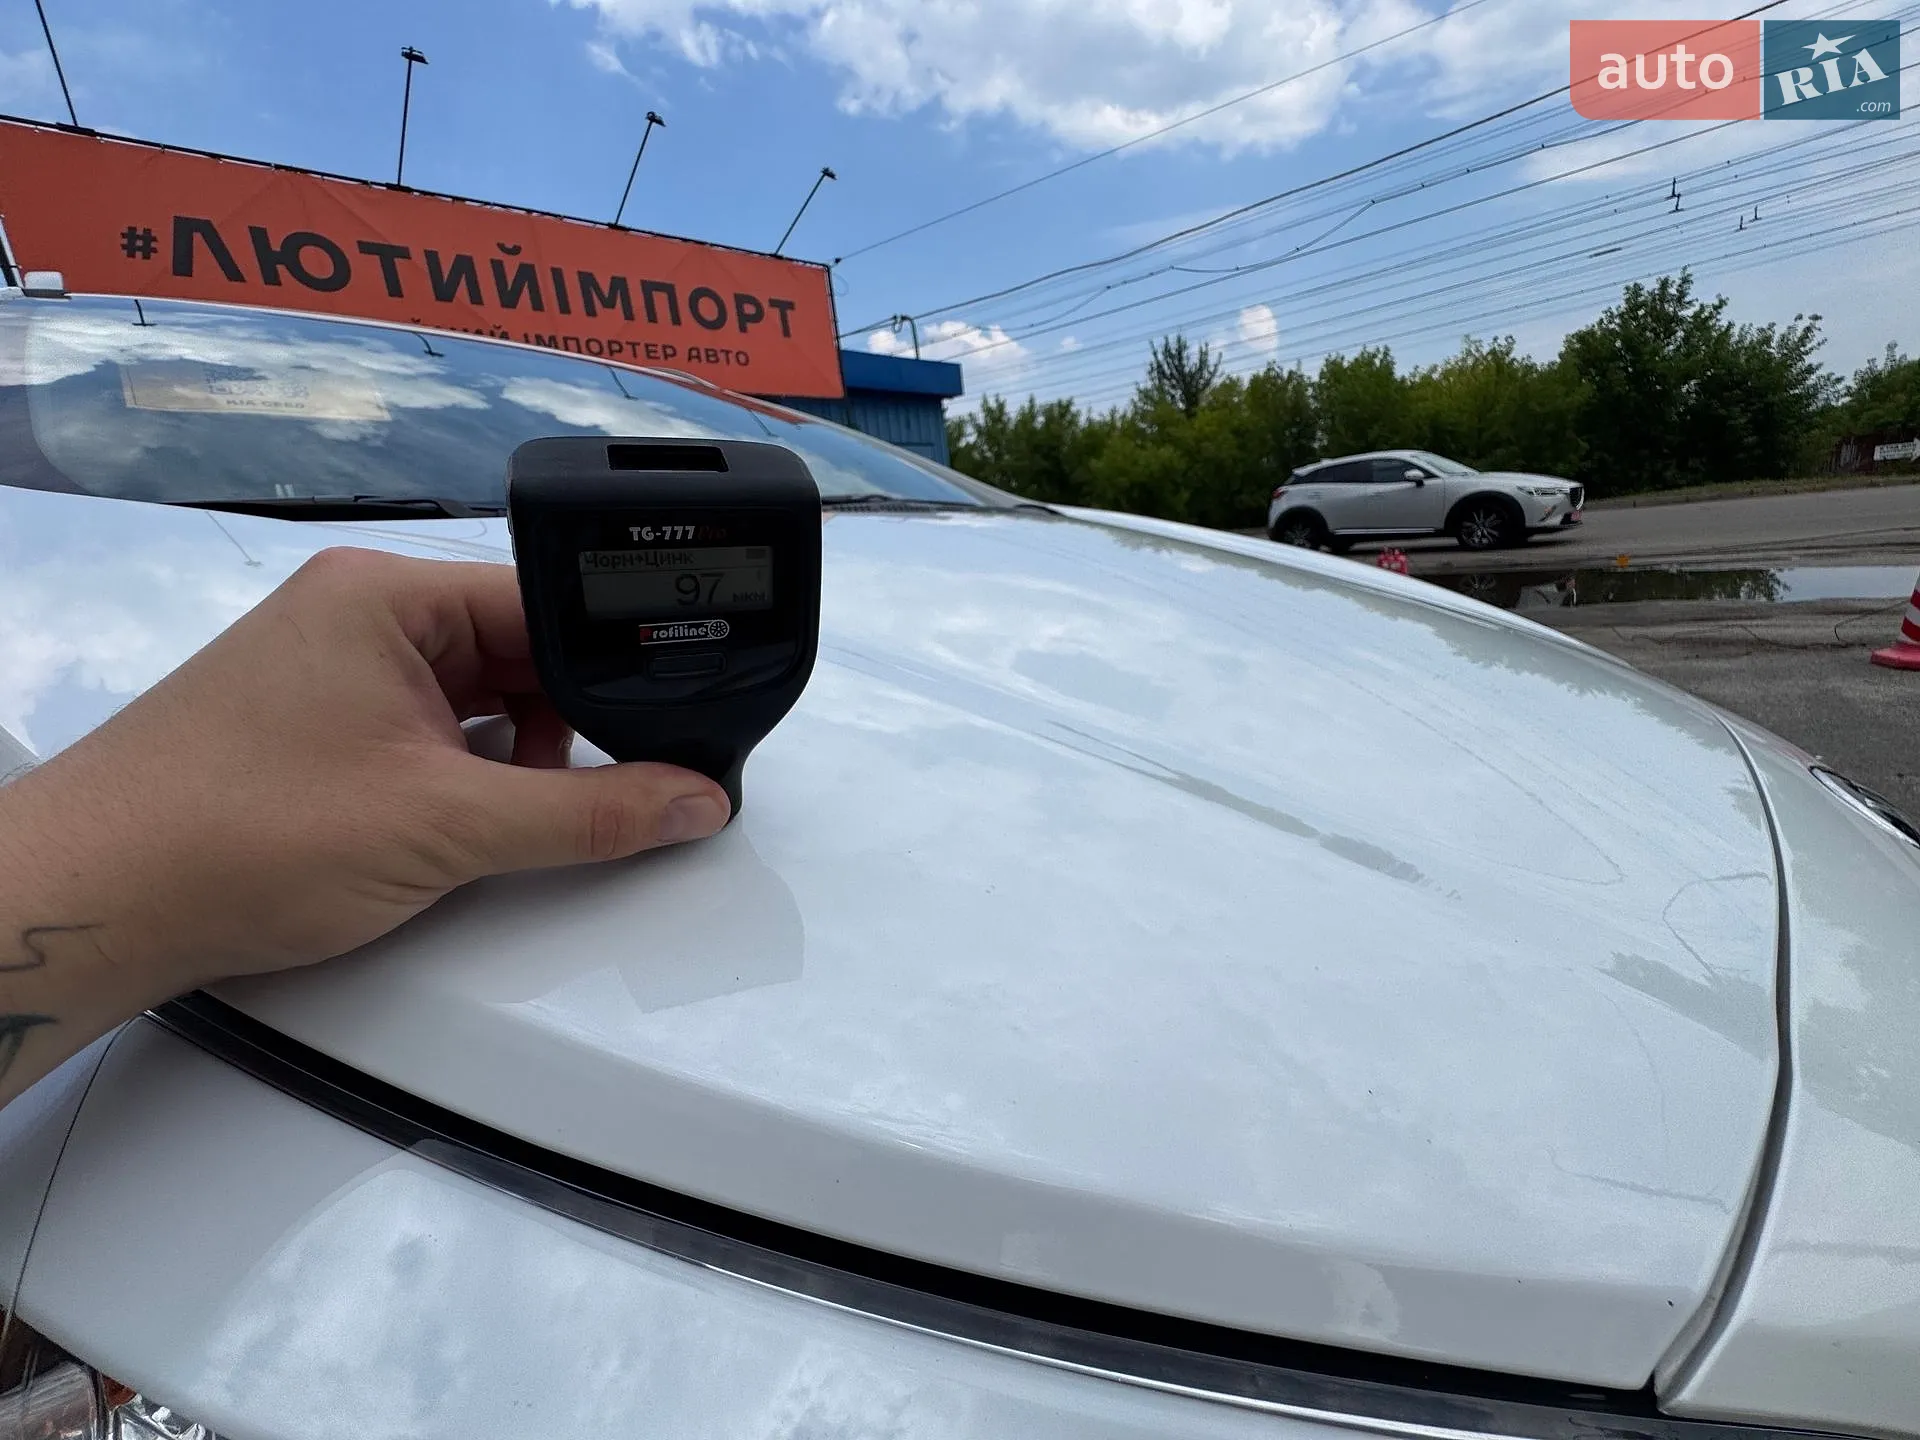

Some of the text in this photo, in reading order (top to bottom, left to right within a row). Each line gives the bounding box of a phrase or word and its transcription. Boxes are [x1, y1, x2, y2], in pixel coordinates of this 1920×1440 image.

[120, 215, 796, 338] #ЛЮТИЙІМПОРТ
[688, 346, 750, 367] АВТО
[629, 525, 695, 541] TG-777
[675, 573, 725, 606] 97
[640, 623, 708, 642] Profiline
